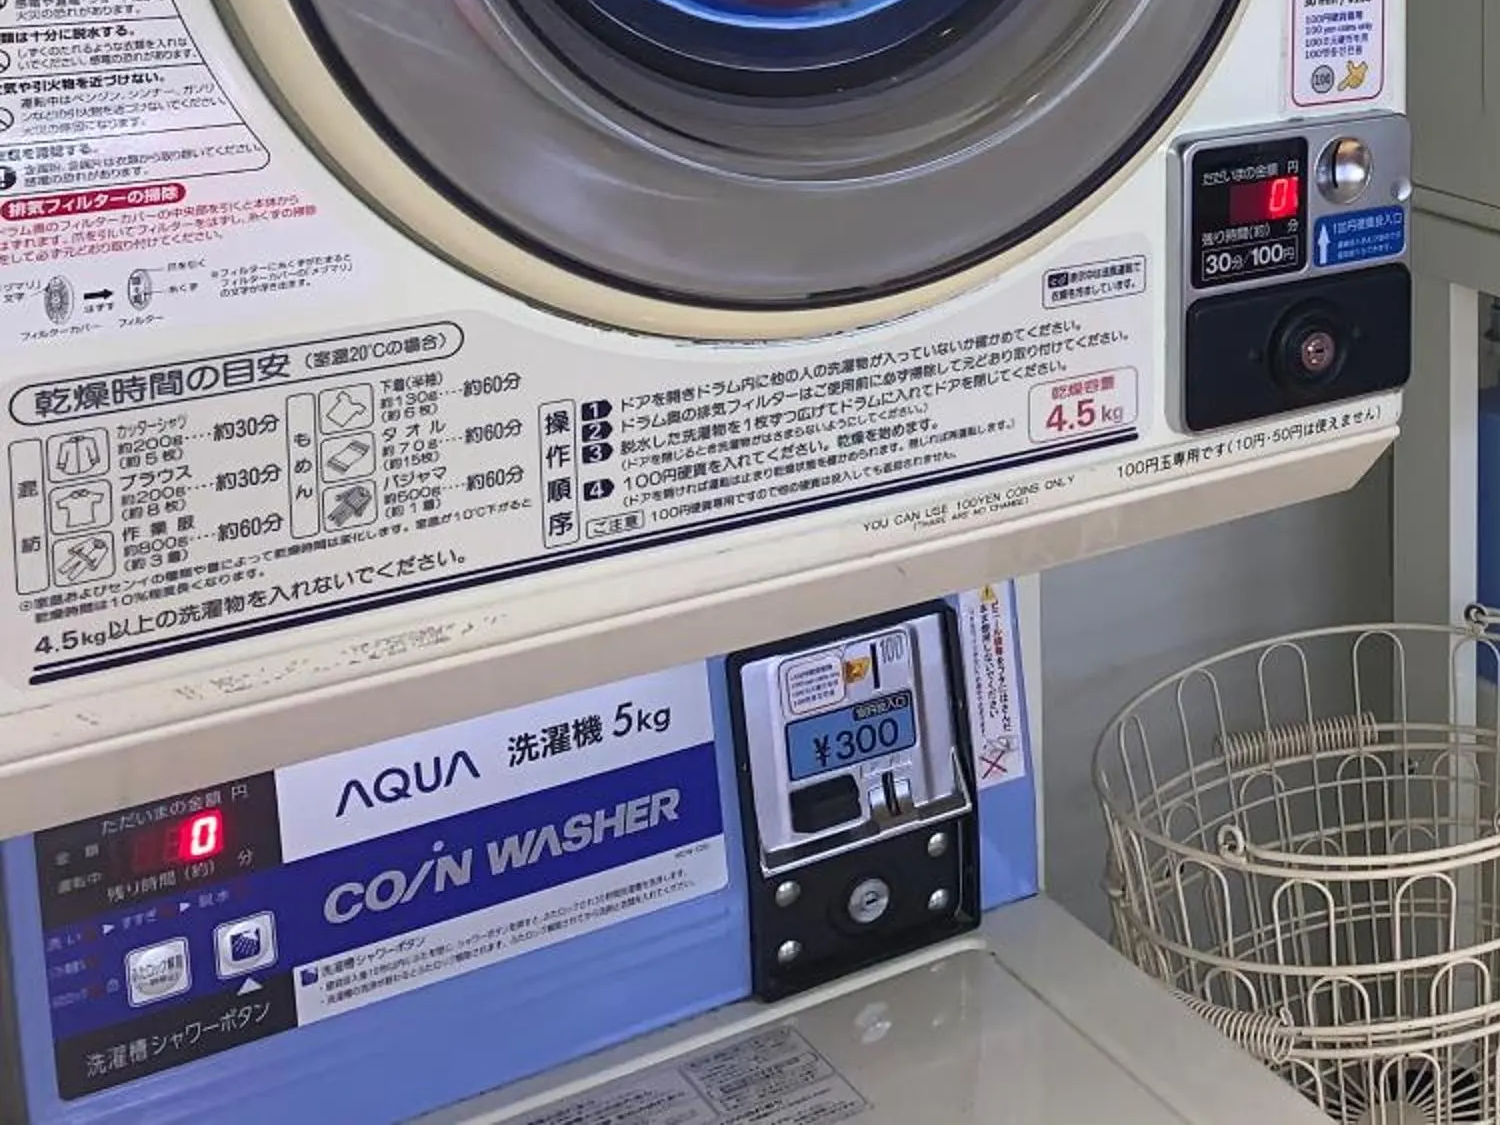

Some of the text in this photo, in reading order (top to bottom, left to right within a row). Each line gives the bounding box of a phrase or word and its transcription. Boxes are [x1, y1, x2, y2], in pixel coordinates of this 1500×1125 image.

[0, 72, 165, 95] 気や引火物を近づけない。
[9, 186, 179, 217] 排気フィルターの掃除
[34, 353, 292, 418] 乾燥時間の目安
[463, 372, 521, 398] 約60分
[213, 414, 280, 442] 約30分
[465, 418, 523, 444] 約60分
[1045, 399, 1124, 432] 4.5 kg
[119, 465, 192, 492] ブラウス
[215, 464, 282, 492] 約30分
[383, 466, 447, 491] パジャマ
[467, 464, 524, 491] 約60分
[544, 410, 573, 537] 操作順序
[863, 518, 888, 532] YOU
[895, 512, 921, 527] CAN
[1044, 475, 1075, 491] ONLY
[217, 512, 284, 542] 約60分
[593, 514, 638, 535] ご注意
[34, 550, 465, 653] 4.5kg以上の洗濯物を入れないでください。
[813, 718, 898, 767] ¥300
[335, 701, 671, 817] AQUA 洗濯機 5kg
[101, 783, 249, 836] ただいまの金額 円
[190, 816, 217, 856] 0
[237, 848, 253, 867] 分
[323, 788, 682, 925] COIN WASHER
[86, 1002, 270, 1077] 洗濯槽シャワーボタン
